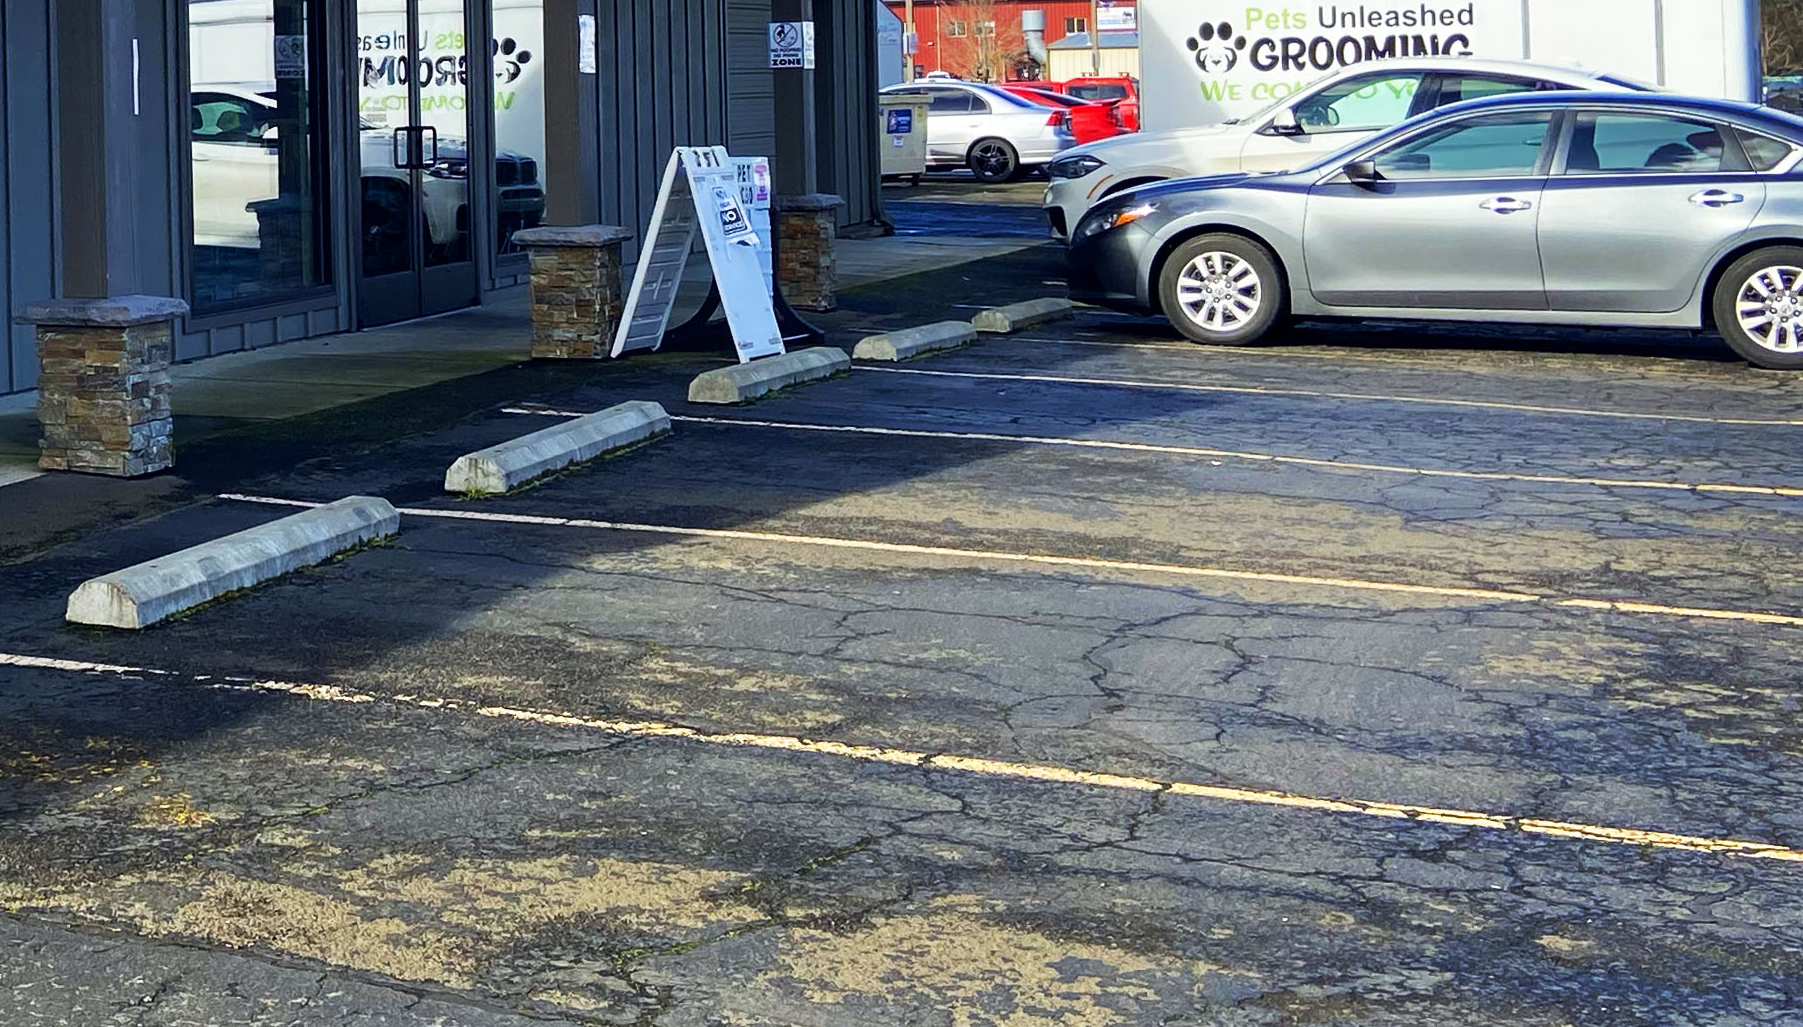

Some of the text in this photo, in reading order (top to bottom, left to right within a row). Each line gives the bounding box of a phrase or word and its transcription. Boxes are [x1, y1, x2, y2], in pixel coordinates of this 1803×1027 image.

[1245, 2, 1474, 30] Pets Unleashed
[771, 58, 802, 66] ZONE
[1200, 80, 1244, 101] WE
